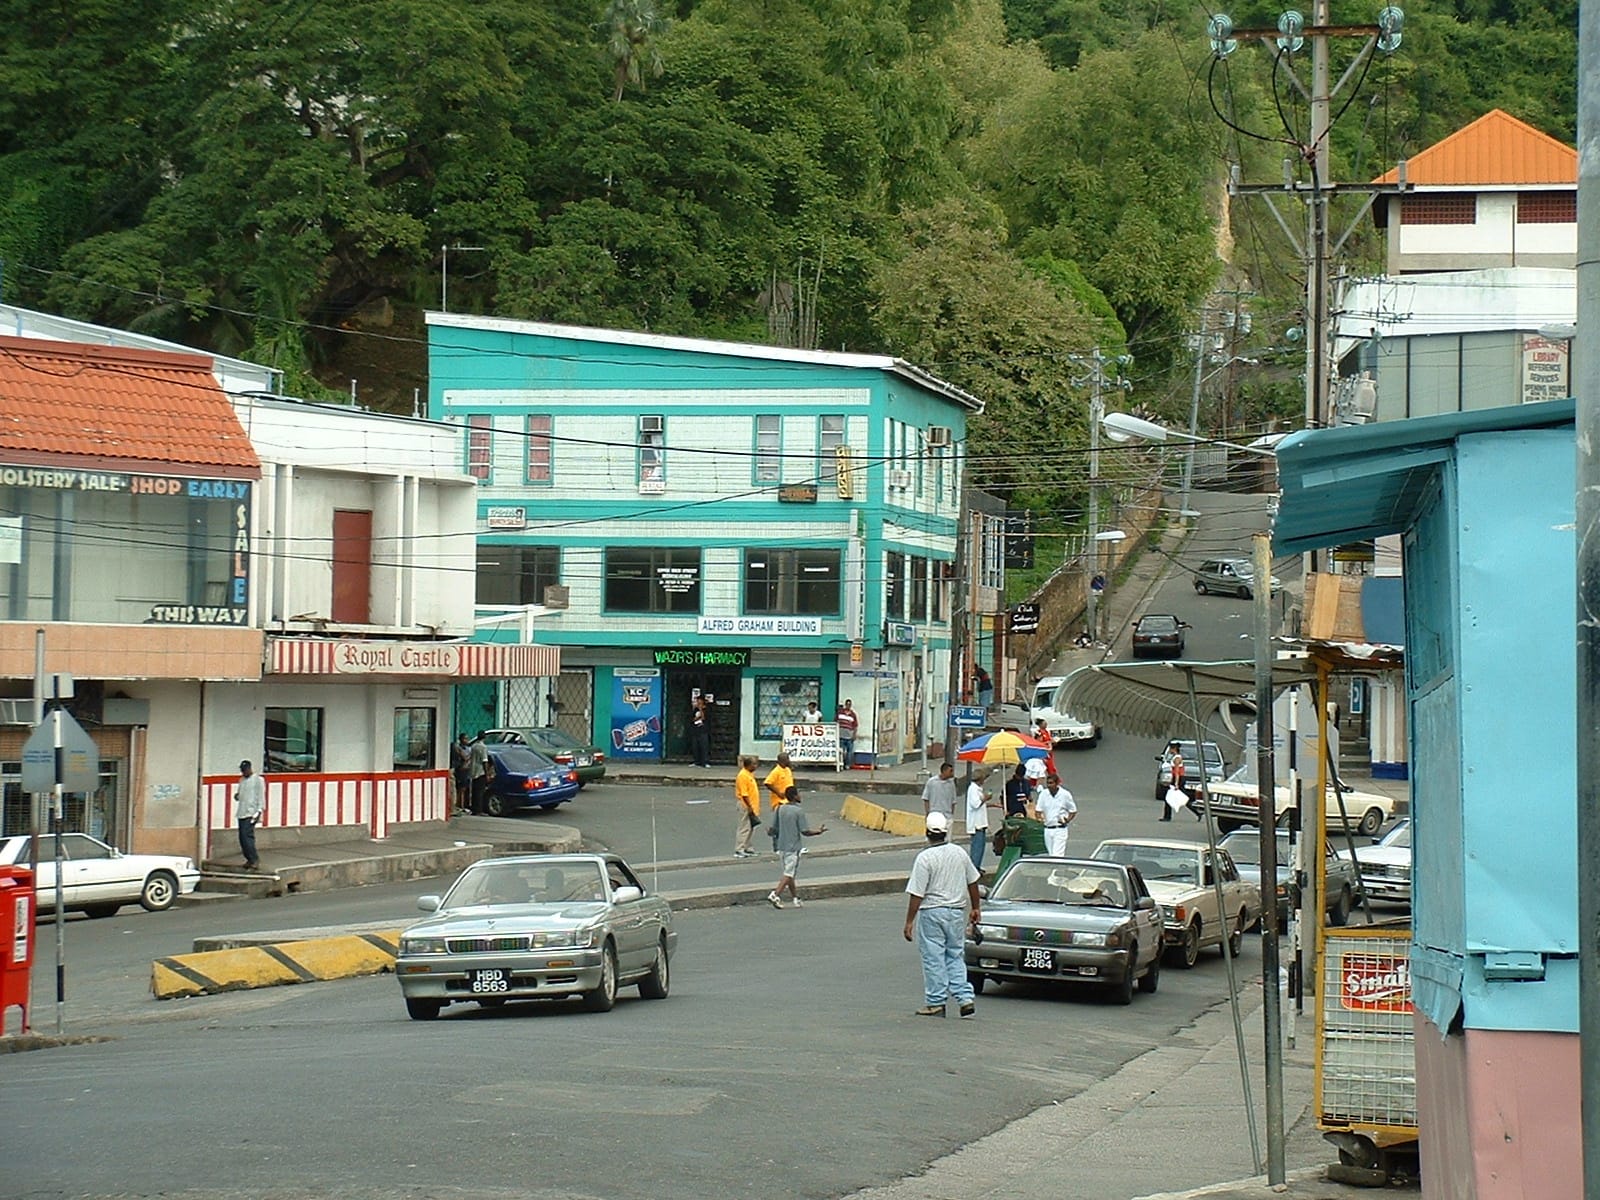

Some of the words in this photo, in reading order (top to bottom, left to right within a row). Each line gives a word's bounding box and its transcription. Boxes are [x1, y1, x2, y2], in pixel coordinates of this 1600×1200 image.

[1530, 373, 1559, 382] SERVICES
[131, 477, 182, 495] SHOP
[188, 481, 247, 499] EARLY
[153, 605, 196, 623] THIS
[197, 606, 247, 624] WAY
[702, 619, 734, 631] ALFRED
[738, 619, 774, 632] GRAHAM
[777, 620, 817, 633] BUILDING
[343, 644, 393, 671] Royal
[400, 647, 451, 668] Castle
[695, 651, 747, 665] PHARMACY
[629, 688, 644, 696] KC
[791, 725, 825, 737] ALIS
[1026, 949, 1051, 960] HBC
[1023, 957, 1052, 970] 2364
[476, 969, 503, 981] HBD
[472, 980, 508, 993] 8563
